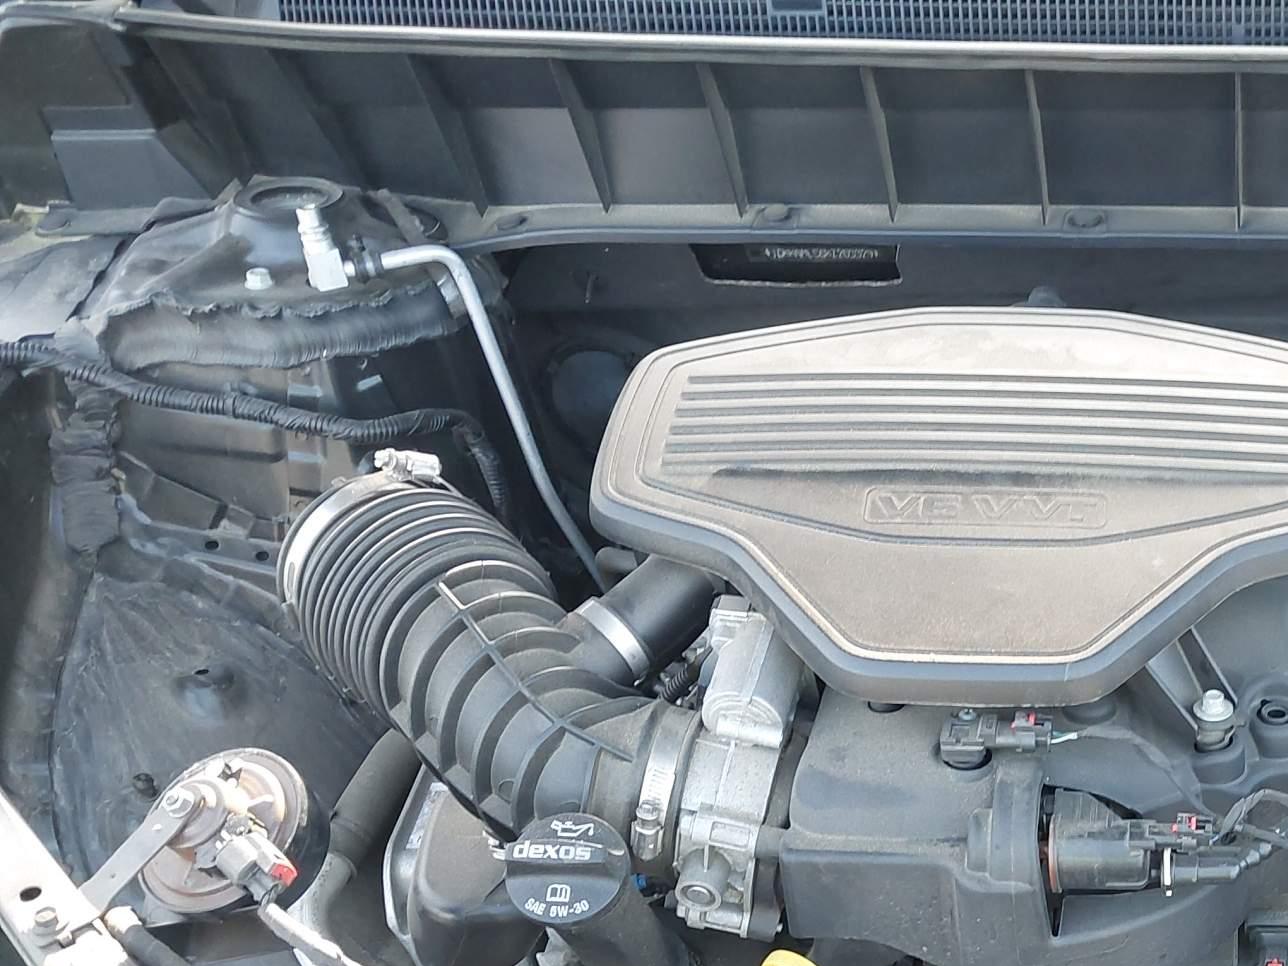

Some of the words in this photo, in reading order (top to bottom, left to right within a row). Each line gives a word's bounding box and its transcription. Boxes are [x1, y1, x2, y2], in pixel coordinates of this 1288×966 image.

[877, 494, 962, 518] V6
[970, 494, 1100, 522] VVT
[512, 840, 591, 860] dexos
[524, 898, 546, 915] SAE
[549, 900, 590, 918] 5W-30
